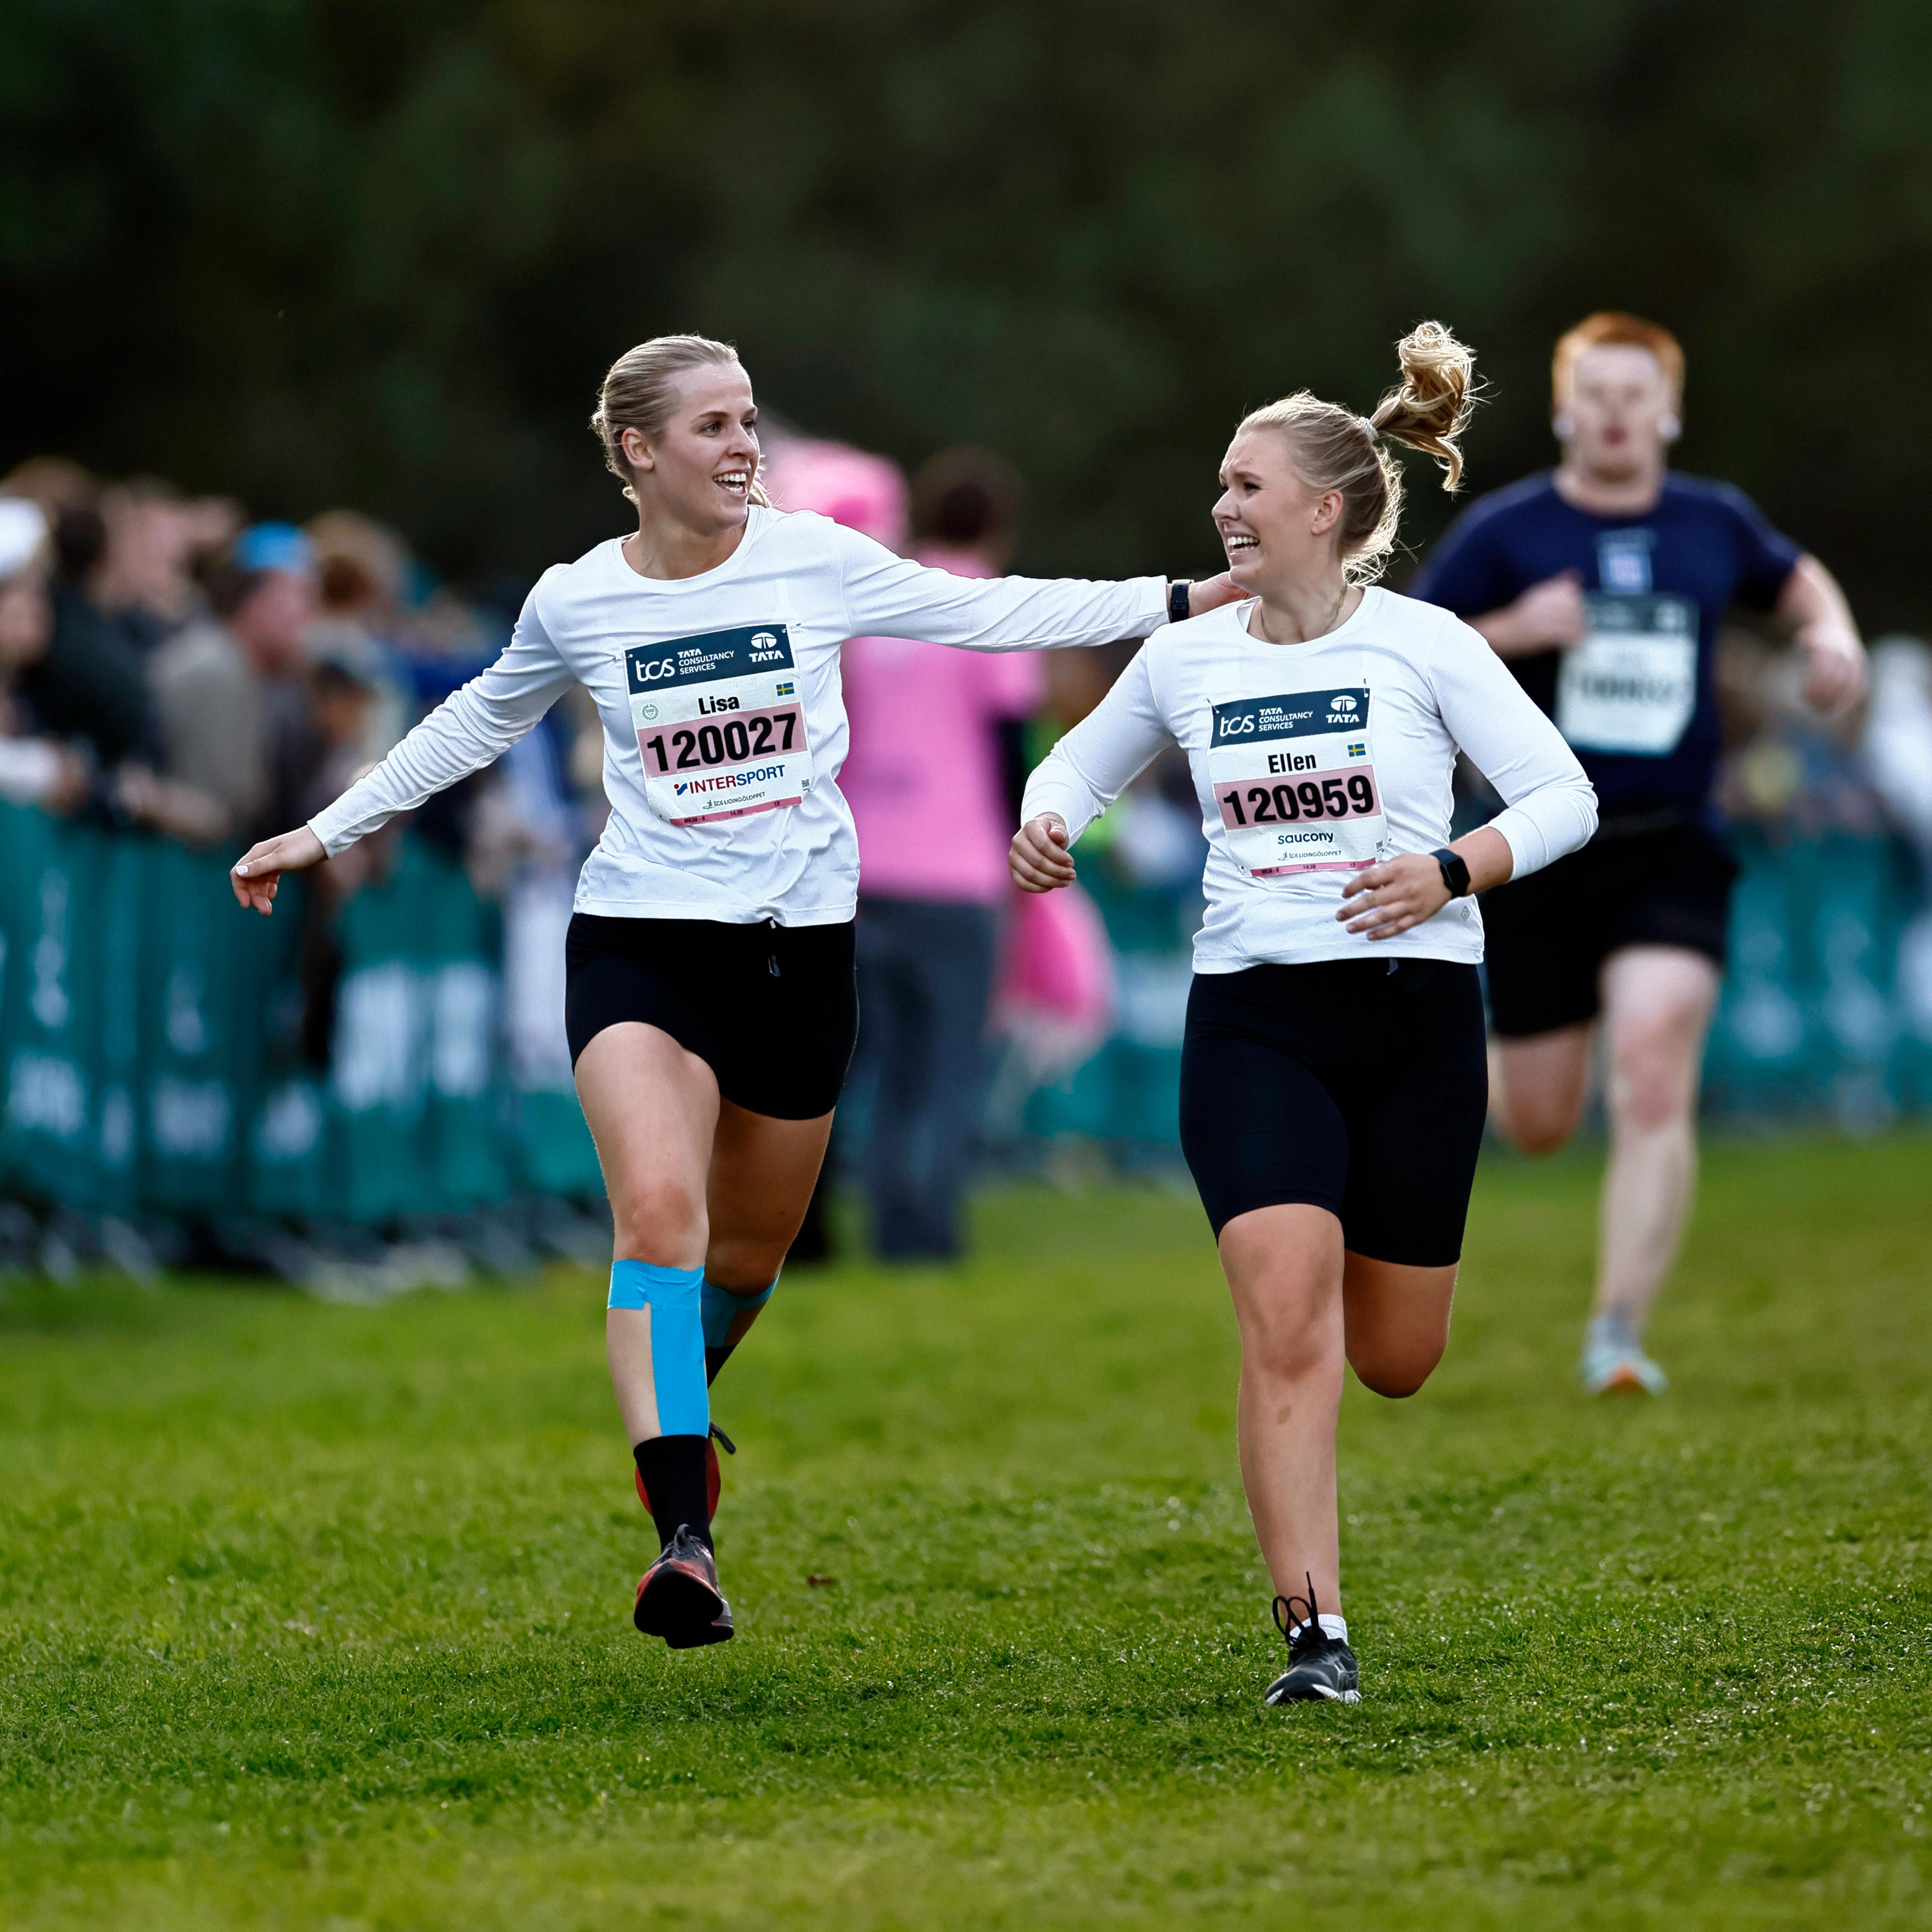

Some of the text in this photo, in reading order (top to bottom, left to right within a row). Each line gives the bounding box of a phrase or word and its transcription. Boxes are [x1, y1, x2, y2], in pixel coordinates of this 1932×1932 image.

[677, 648, 702, 658] TATA
[679, 651, 735, 667] CONSULTANCY
[749, 650, 784, 663] TATA
[635, 658, 675, 682] tcs
[679, 662, 716, 675] SERVICES
[698, 696, 740, 714] Lisa
[1259, 707, 1283, 715] TATA
[1259, 711, 1313, 723] CONSULTANCY
[1326, 713, 1359, 723] TATA
[1220, 714, 1254, 737] tcs
[1258, 722, 1293, 732] SERVICES
[647, 712, 796, 771] 120027
[1268, 753, 1317, 774] Ellen
[690, 764, 785, 794] INTERSPORT
[724, 792, 765, 805] LIDINGÖLOPPET
[1223, 775, 1374, 825] 120959
[1277, 832, 1334, 845] saucony
